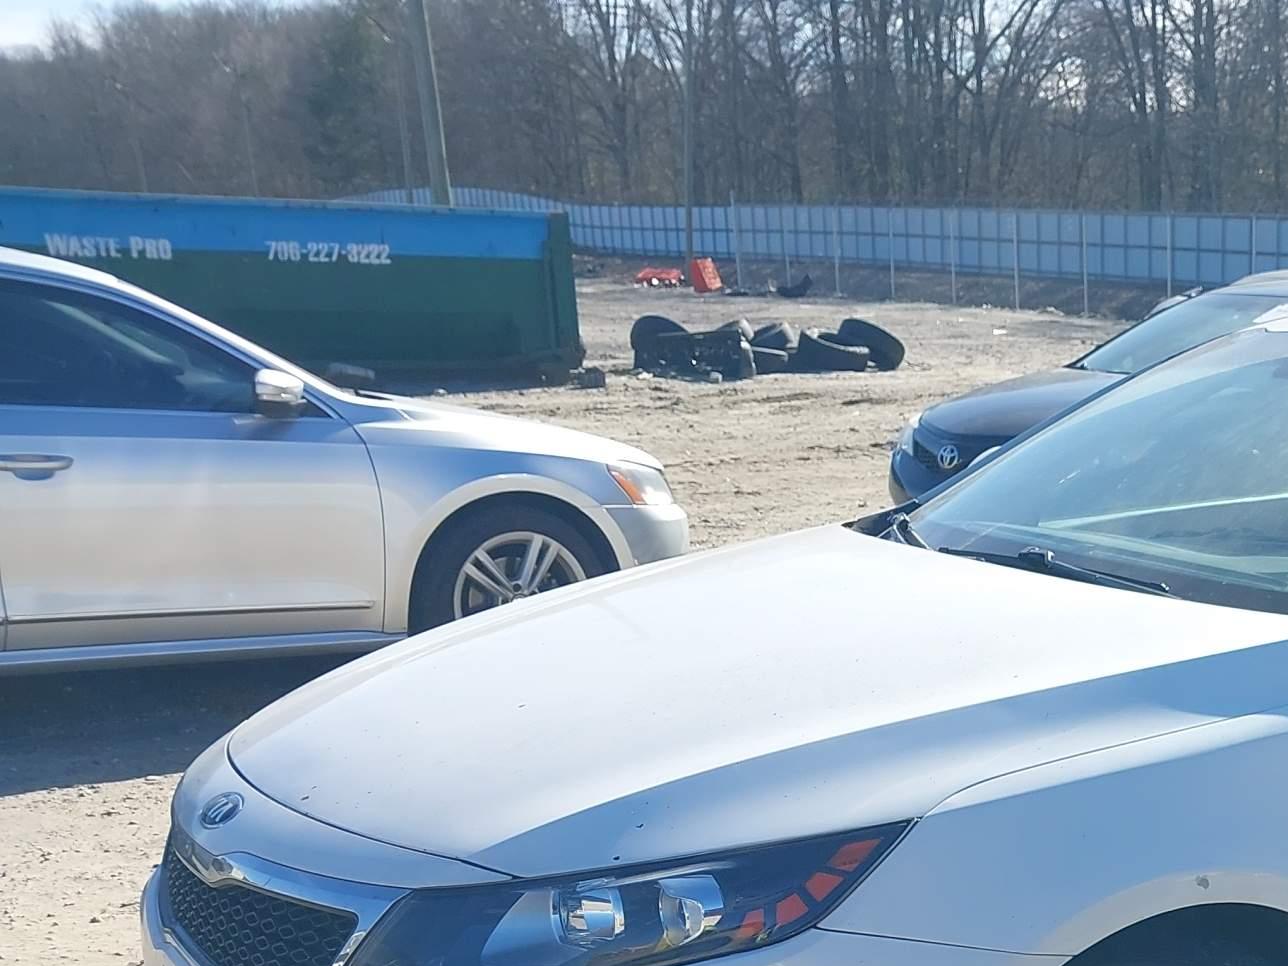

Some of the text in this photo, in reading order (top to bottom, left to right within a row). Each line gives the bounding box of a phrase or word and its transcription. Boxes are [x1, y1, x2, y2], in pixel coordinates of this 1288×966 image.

[44, 232, 172, 260] WASTE PRO
[264, 240, 392, 265] 706-227-3222
